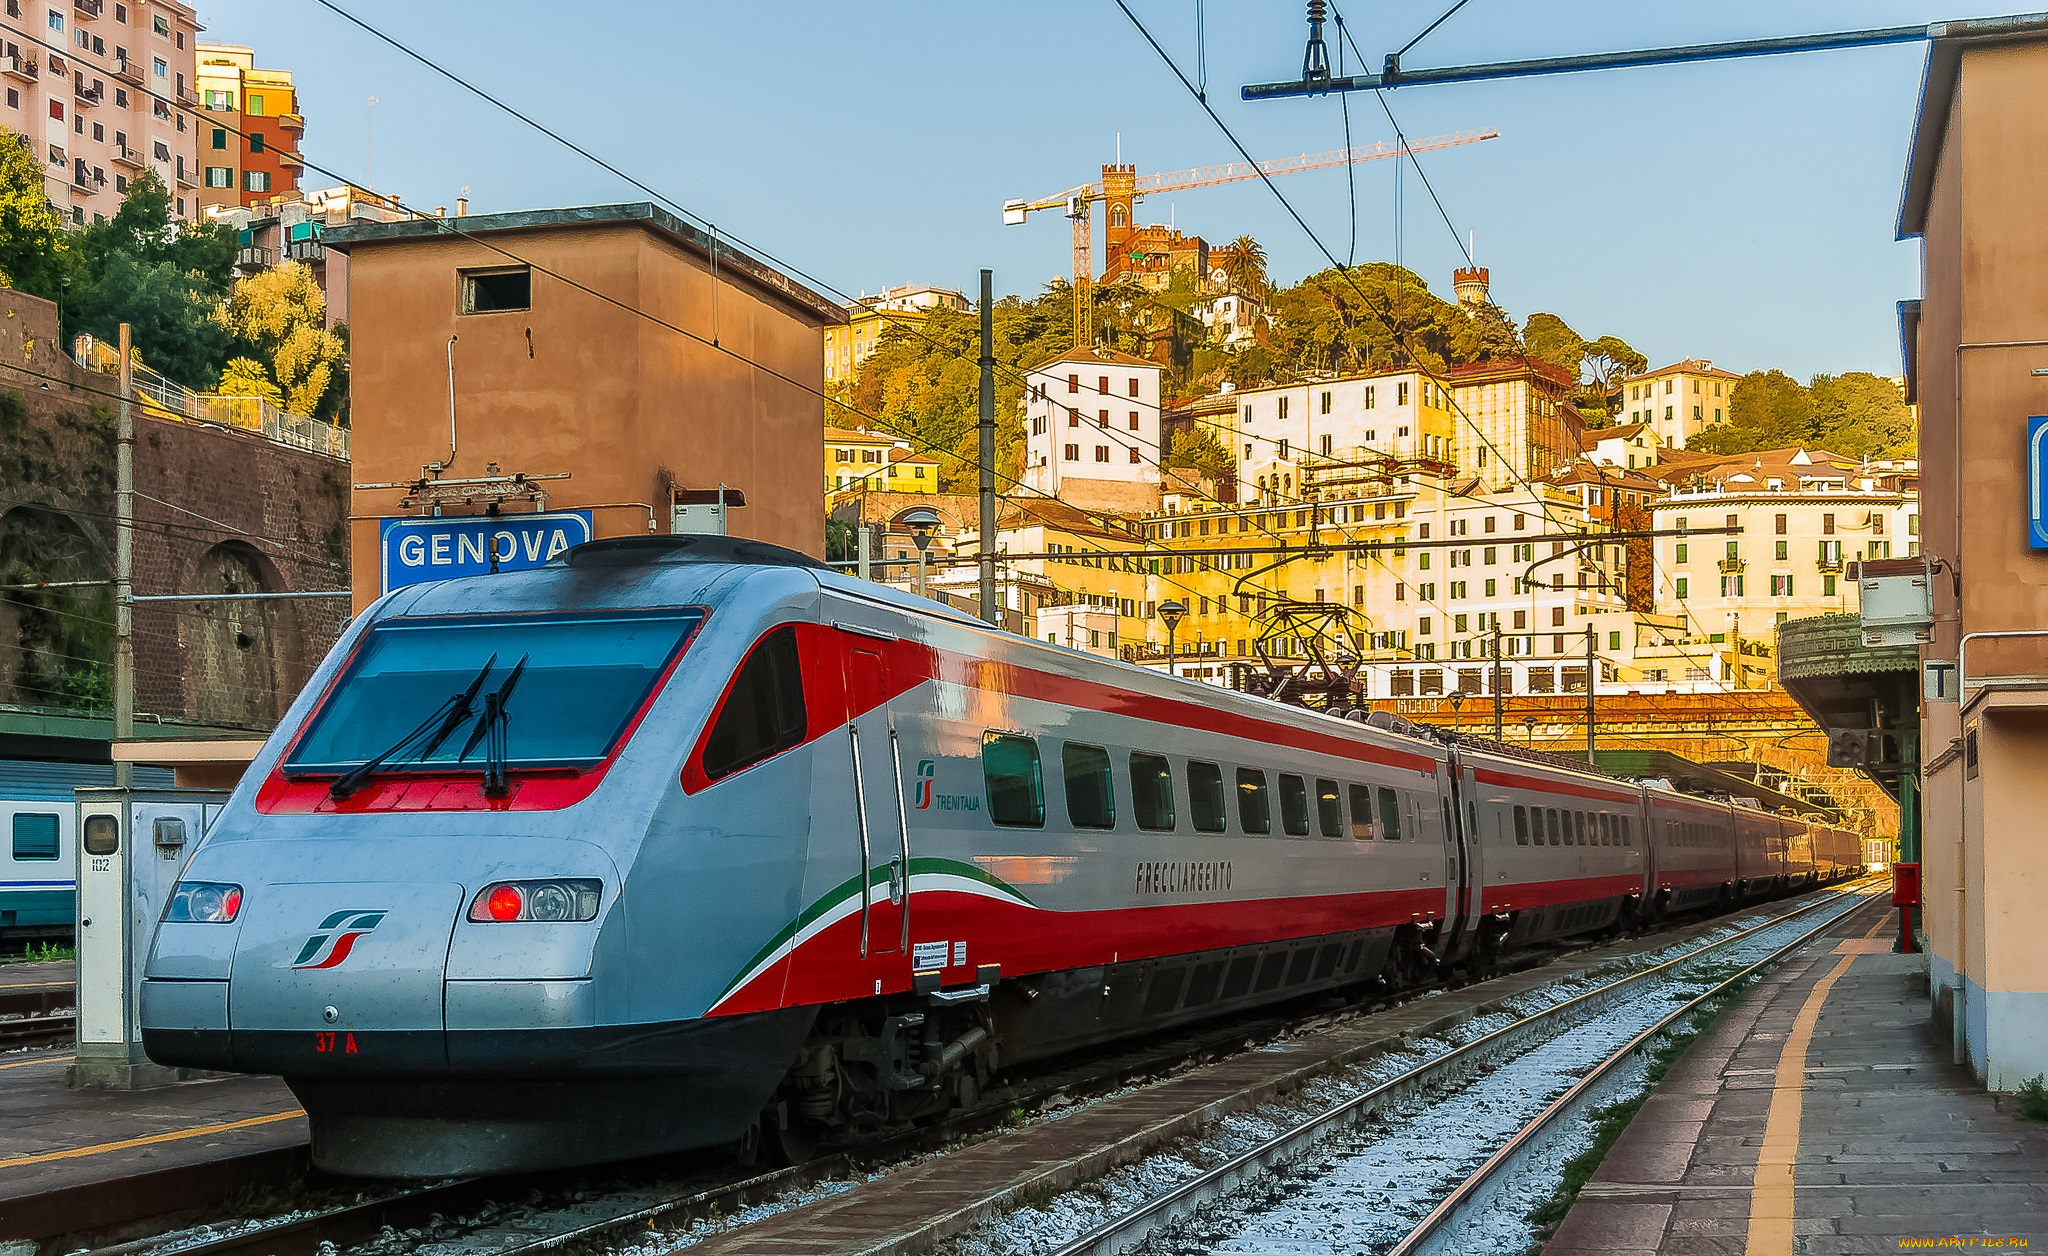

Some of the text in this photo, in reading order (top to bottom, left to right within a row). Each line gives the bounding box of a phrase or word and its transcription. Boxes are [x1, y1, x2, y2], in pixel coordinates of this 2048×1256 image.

[399, 529, 570, 567] GENOVA
[1926, 663, 1956, 698] T
[935, 793, 981, 812] TRENITALIA
[91, 858, 110, 872] 102
[1136, 861, 1233, 894] FRECCIARGENTO
[315, 1031, 359, 1054] 37 A
